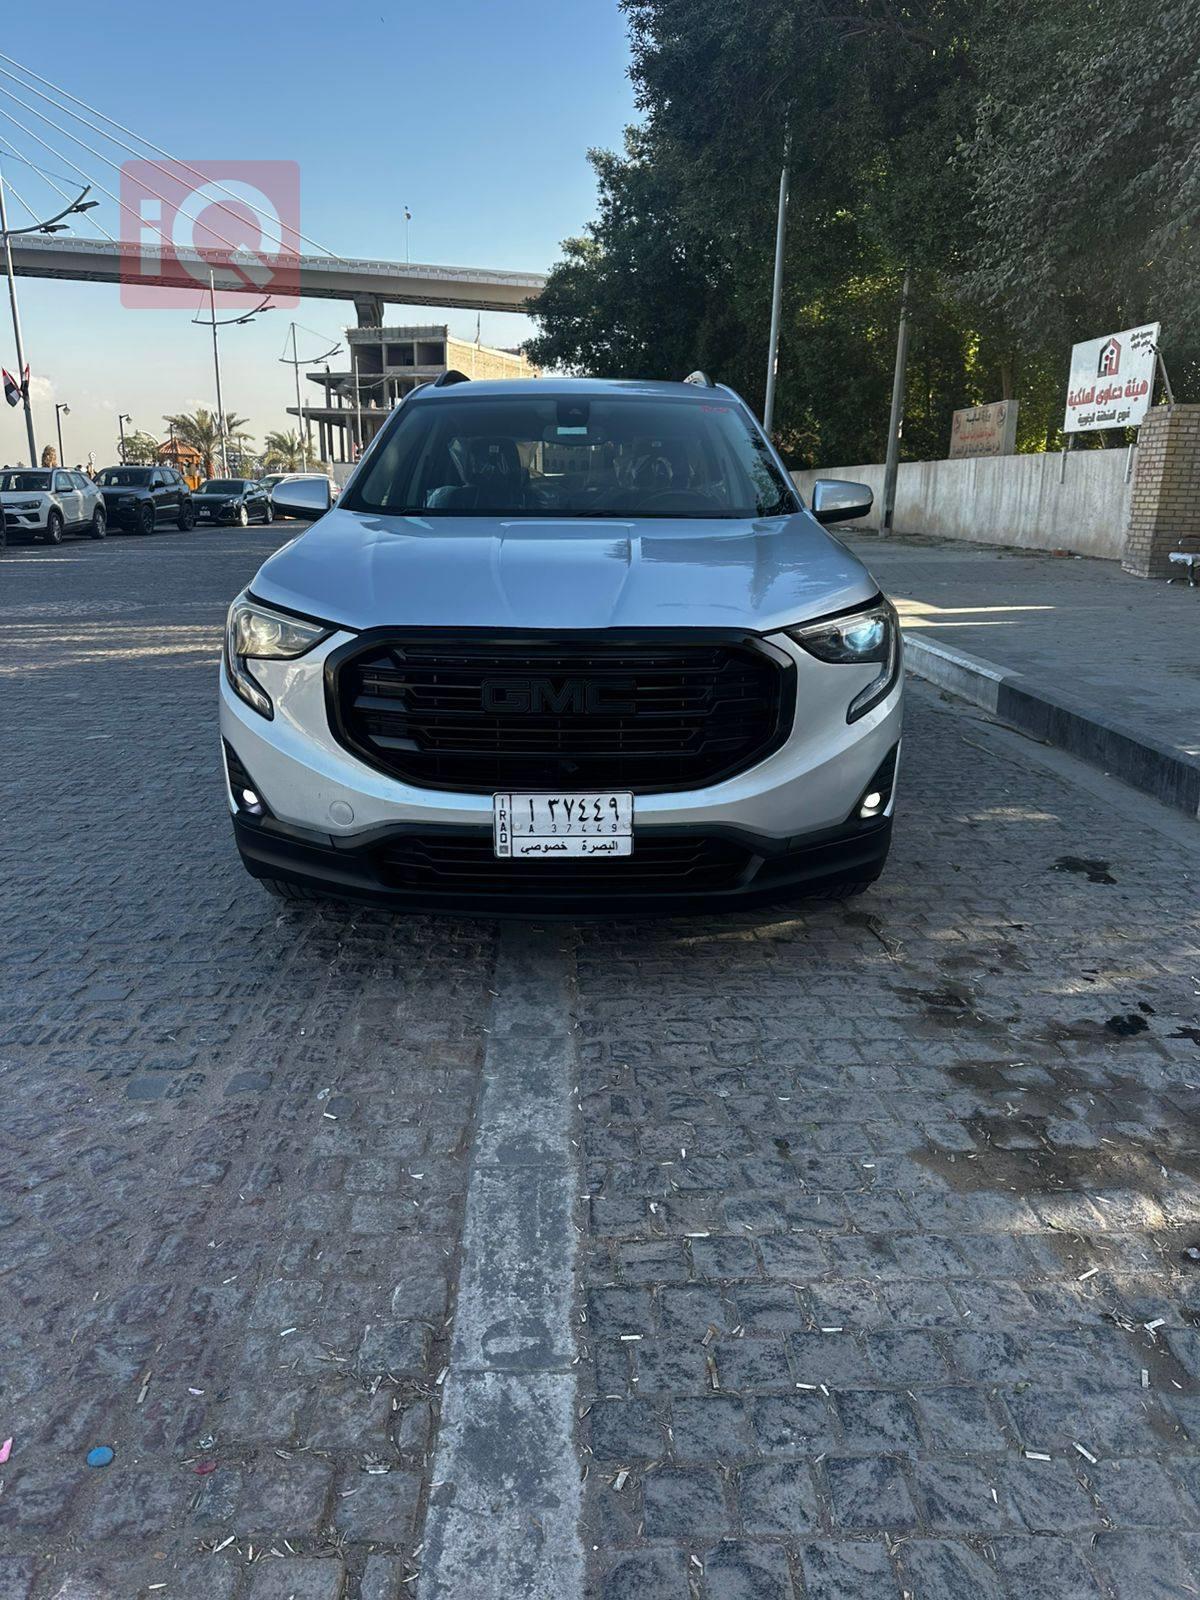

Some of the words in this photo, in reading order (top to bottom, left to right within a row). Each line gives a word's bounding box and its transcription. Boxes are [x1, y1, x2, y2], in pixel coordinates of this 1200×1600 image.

[1067, 385, 1096, 411] الملكية
[1095, 383, 1123, 406] دعاوى
[1124, 377, 1149, 402] هيئة
[480, 678, 637, 714] GMC
[520, 841, 569, 855] خصوصي
[581, 840, 619, 854] البصرة
